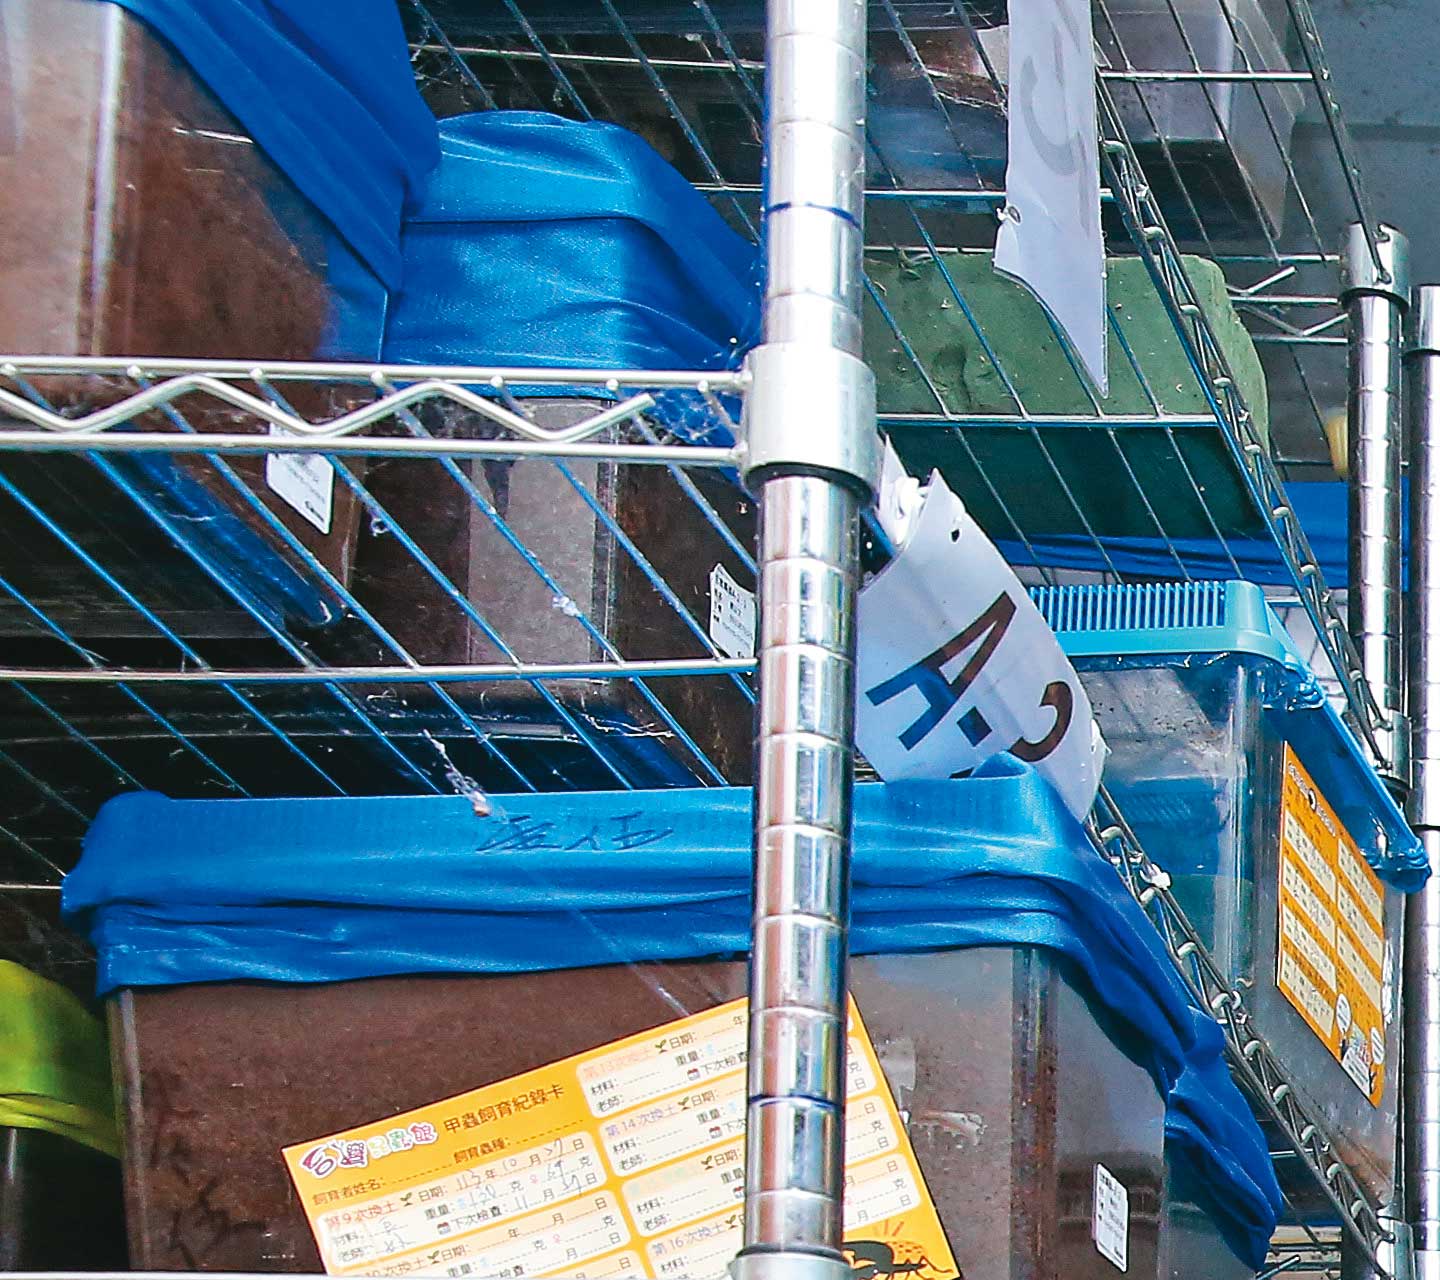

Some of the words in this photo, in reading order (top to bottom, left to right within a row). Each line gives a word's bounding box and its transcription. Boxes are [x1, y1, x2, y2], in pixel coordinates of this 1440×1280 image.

[443, 1084, 565, 1134] 甲蟲飼育紀錄卡
